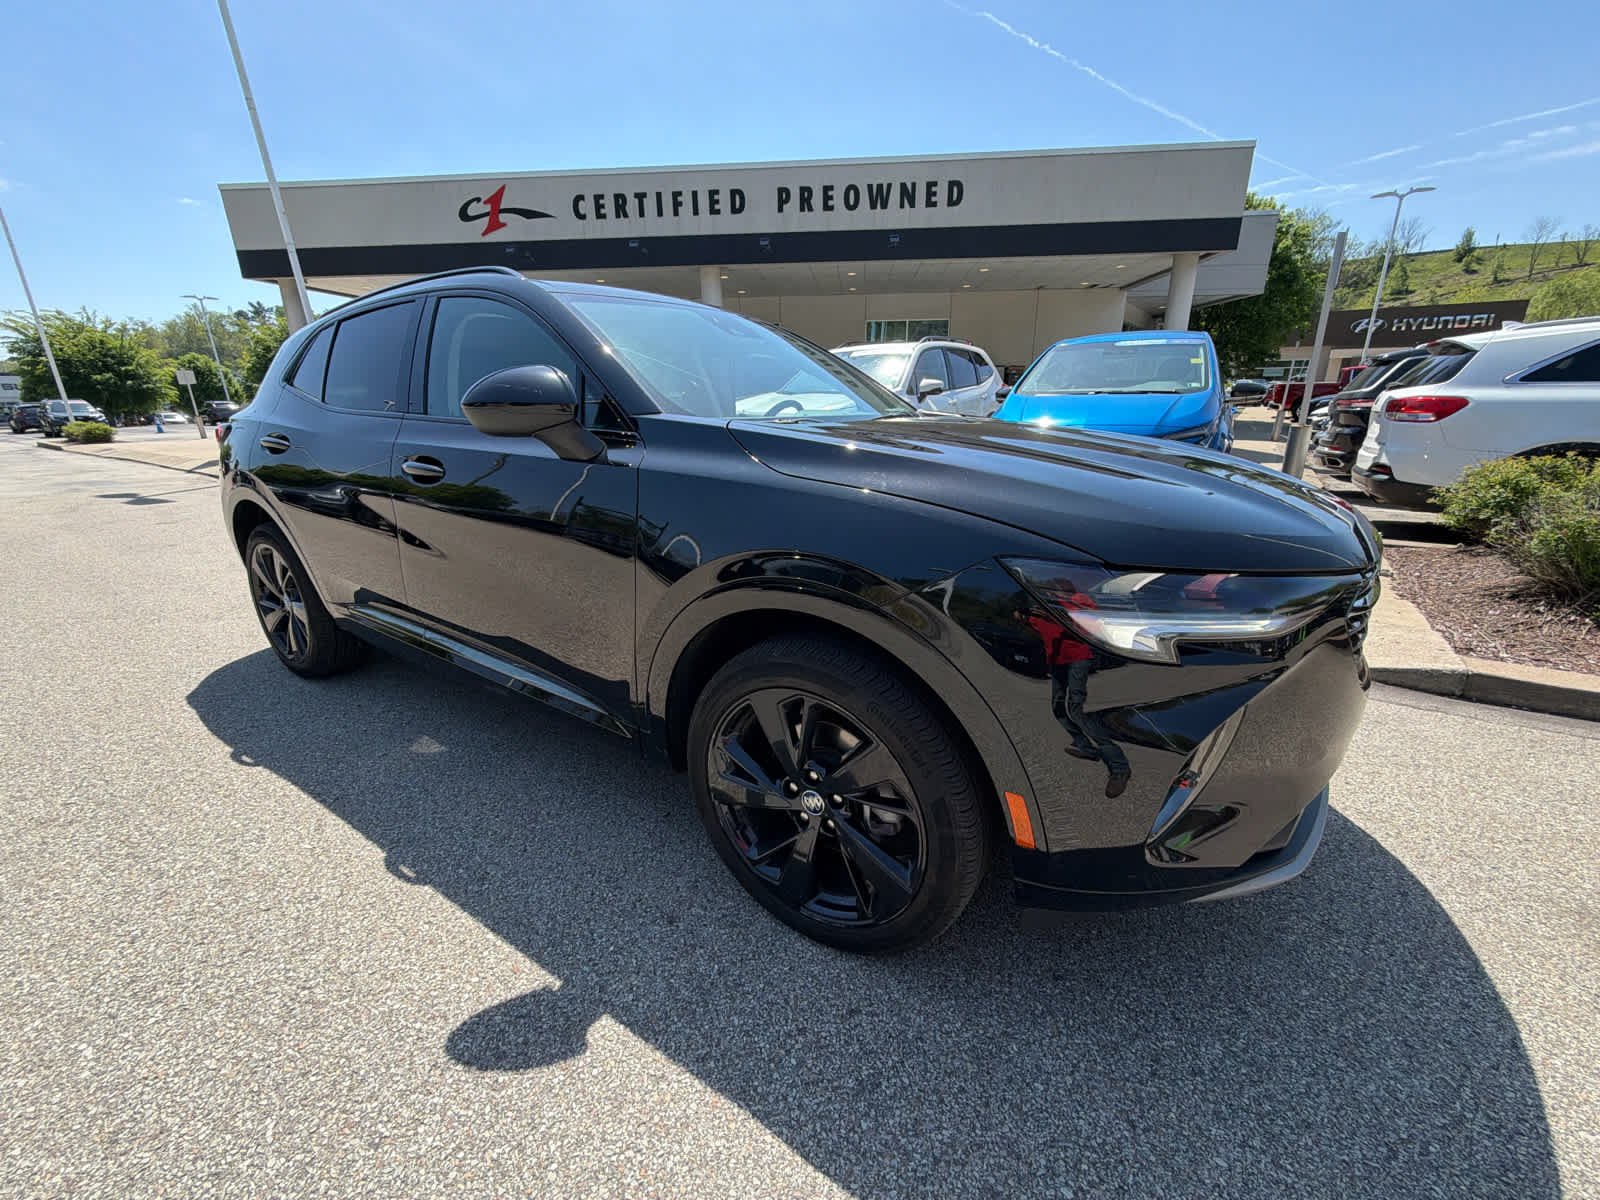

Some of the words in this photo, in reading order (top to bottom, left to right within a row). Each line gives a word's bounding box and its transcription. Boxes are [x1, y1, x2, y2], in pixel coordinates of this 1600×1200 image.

[572, 189, 746, 220] CERTIFIED
[777, 180, 964, 213] PREOWNED
[1391, 314, 1496, 331] HYUNDAI
